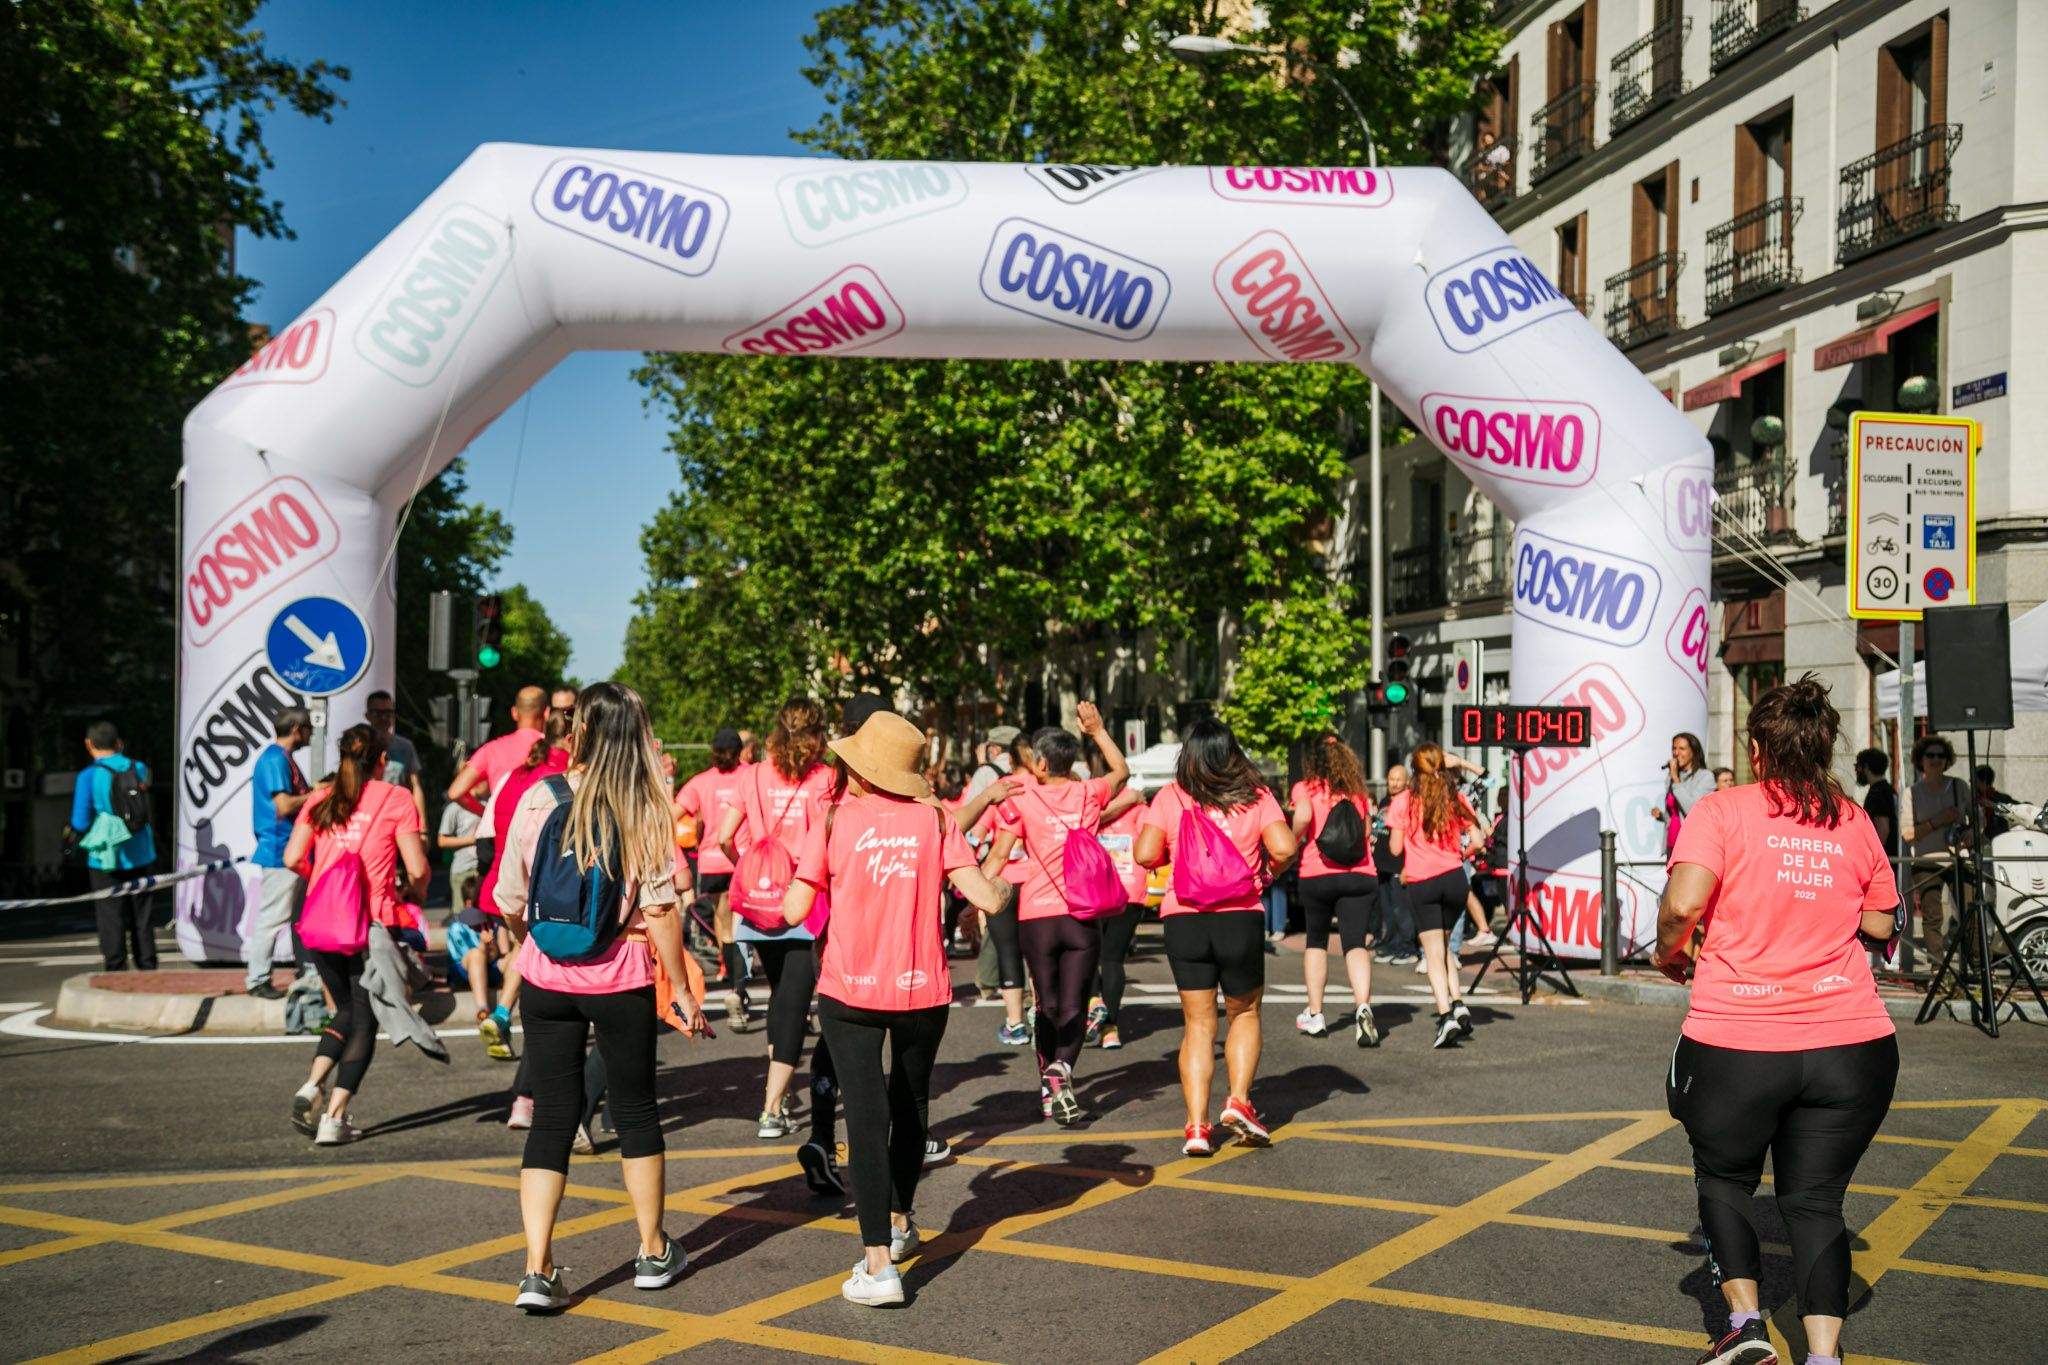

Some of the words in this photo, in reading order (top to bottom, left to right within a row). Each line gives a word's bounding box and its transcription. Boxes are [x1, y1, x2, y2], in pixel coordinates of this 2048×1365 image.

[553, 166, 712, 258] COSMO
[795, 165, 951, 231] COSMO
[371, 218, 498, 367] COSMO
[1000, 232, 1153, 331] COSMO
[1444, 257, 1565, 335] COSM
[1232, 249, 1346, 360] COSMO
[1435, 404, 1584, 473] COSMO
[1866, 434, 1963, 453] PRECAUCIÓN
[1917, 478, 1962, 487] EXCLUSIVO
[1925, 468, 1954, 477] CARRIL
[187, 492, 320, 627] COSMO
[1516, 541, 1644, 632] COSMO
[1873, 577, 1892, 589] 30
[1767, 835, 1844, 856] CARRERA
[1783, 853, 1805, 868] DE
[1810, 856, 1830, 870] LA
[1776, 870, 1834, 888] MUJER
[1793, 889, 1817, 900] 2022
[1732, 983, 1783, 996] OYSHO
